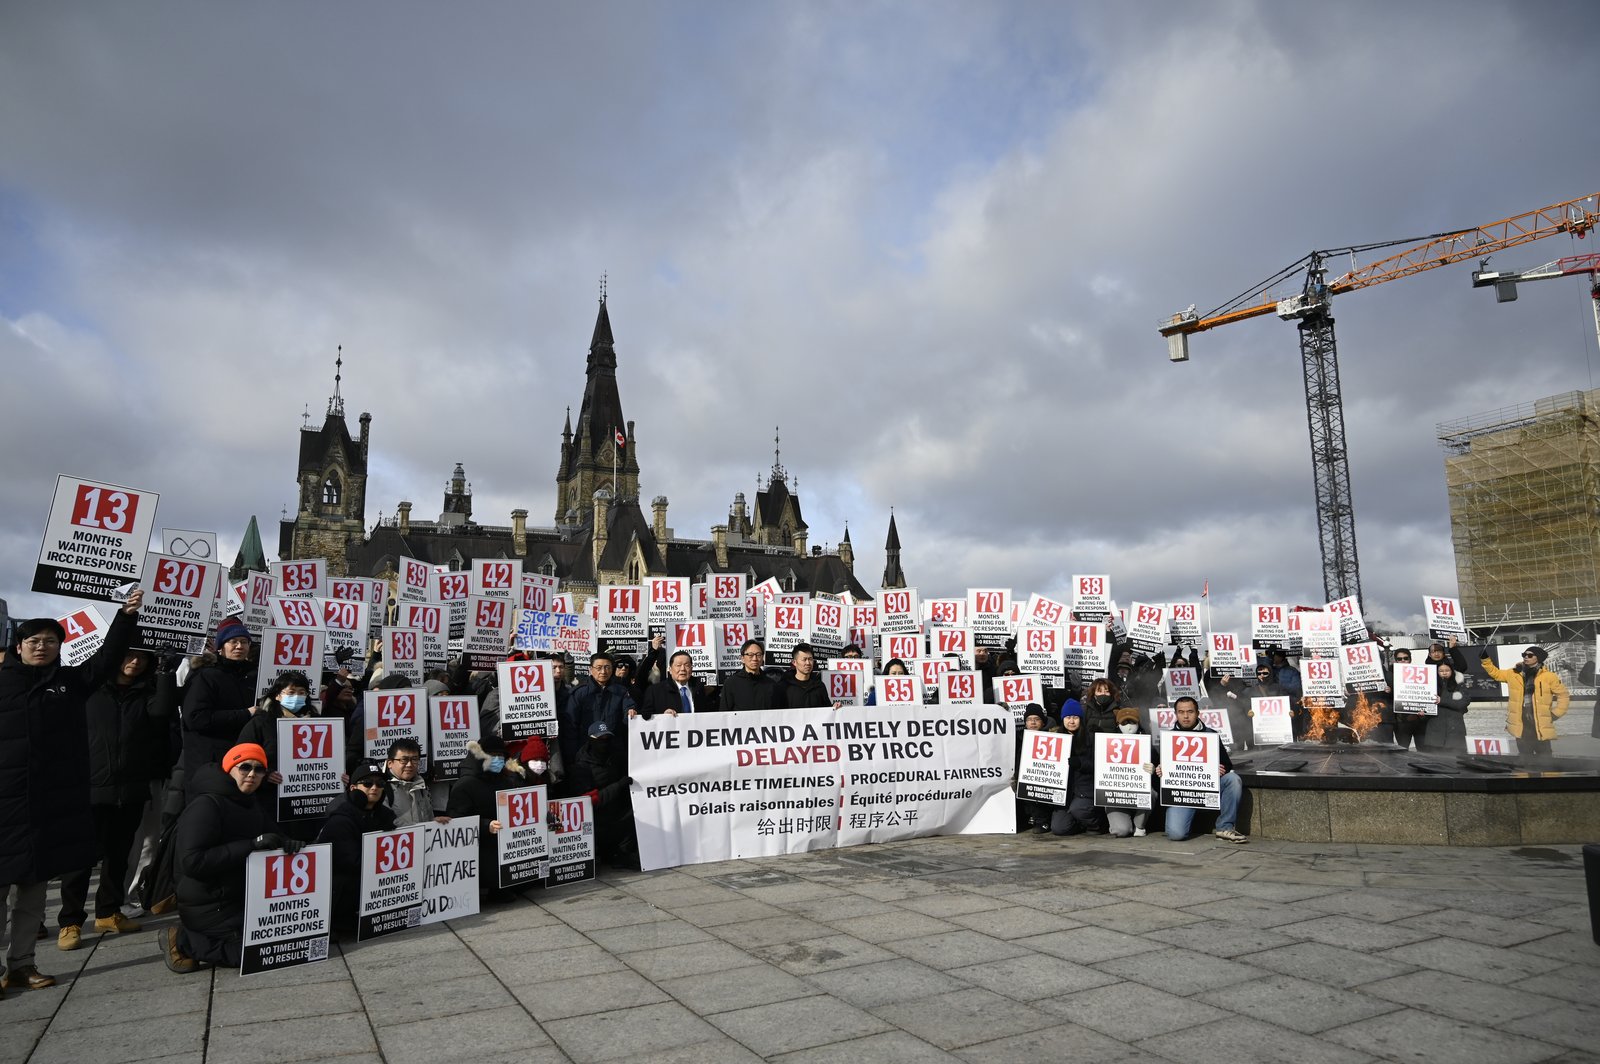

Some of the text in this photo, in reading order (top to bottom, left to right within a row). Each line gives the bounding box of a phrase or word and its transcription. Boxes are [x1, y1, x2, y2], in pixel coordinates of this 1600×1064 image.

[79, 488, 130, 531] 13
[73, 531, 122, 547] MONTHS
[58, 540, 132, 562] WAITING FOR
[47, 551, 137, 574] IRCC RESPONSE
[55, 571, 122, 586] NO TIMELINES
[159, 561, 200, 596] 30
[286, 564, 314, 590] 35
[408, 564, 425, 588] 39
[486, 564, 510, 588] 42
[1082, 578, 1102, 594] 38
[58, 582, 114, 596] NO RESULTS
[254, 578, 270, 606] 20
[442, 576, 466, 600] 32
[526, 586, 545, 610] 40
[656, 581, 678, 602] 15
[718, 578, 736, 598] 53
[155, 597, 193, 608] MONTHS
[613, 590, 636, 612] 11
[888, 592, 908, 612] 90
[979, 592, 1000, 612] 70
[1036, 600, 1060, 622] 35
[1434, 600, 1452, 616] 37
[138, 615, 204, 630] RCC RESPONSE
[144, 606, 200, 620] WAITING FOR
[284, 600, 314, 626] 36
[327, 602, 354, 629] 20
[412, 607, 437, 632] 40
[479, 601, 501, 628] 54
[523, 610, 578, 626] STOP THE
[778, 607, 800, 629] 34
[819, 606, 838, 626] 68
[856, 608, 874, 626] 55
[935, 603, 954, 622] 33
[1140, 606, 1159, 625] 32
[1175, 605, 1193, 620] 28
[1261, 608, 1279, 622] 31
[67, 616, 84, 635] 4
[680, 624, 702, 646] 71
[727, 624, 746, 646] 53
[70, 634, 100, 649] MONTHS
[154, 631, 192, 642] TIMELINES
[394, 633, 415, 659] 38
[552, 638, 590, 652] TOGETHER
[941, 631, 962, 651] 72
[1030, 630, 1052, 651] 65
[1073, 626, 1093, 646] 11
[1216, 634, 1231, 650] 37
[68, 642, 96, 658] WAITING
[278, 634, 309, 665] 34
[892, 638, 915, 658] 40
[1349, 647, 1370, 665] 39
[514, 665, 540, 692] 62
[1173, 671, 1189, 686] 37
[1311, 662, 1330, 679] 39
[834, 674, 853, 697] 81
[888, 679, 909, 701] 35
[951, 675, 972, 698] 43
[1006, 678, 1030, 702] 34
[508, 704, 535, 712] WAITING
[514, 694, 542, 702] MONTHS
[382, 696, 412, 726] 42
[444, 702, 466, 730] 41
[520, 710, 552, 718] RESPONSE
[298, 725, 328, 758] 37
[640, 718, 1006, 750] WE DEMAND A TIMELY DECISION
[736, 742, 934, 767] DELAYED BY IRCC
[1035, 736, 1058, 762] 51
[1109, 738, 1136, 764] 37
[1175, 736, 1204, 762] 22
[288, 772, 336, 782] WAITING FOR
[297, 763, 328, 772] MONTHS
[1168, 772, 1196, 780] WAITING
[284, 782, 340, 793] IRCC RESPONSE
[646, 766, 1002, 798] REASONABLE TIMELINES PROCEDURAL FAIRNESS
[1180, 780, 1216, 788] RESPONSE
[512, 792, 536, 826] 31
[689, 788, 972, 816] Délais raisonnables Équité procédurale
[562, 802, 582, 832] 40
[758, 810, 918, 836] 给出时限 程序公平
[512, 828, 536, 840] MONTHS
[380, 834, 410, 872] 36
[503, 844, 546, 861] IRCC RESPONSE
[506, 839, 530, 850] WAITING
[271, 854, 310, 897] 18
[378, 874, 409, 888] MONTHS
[424, 860, 476, 889] HAT ARE
[370, 882, 416, 900] WAITING FOR
[269, 898, 310, 913] MONTHS
[365, 892, 420, 912] IRCC RESPONSE
[422, 898, 436, 918] OU
[258, 908, 319, 926] WAITING FOR
[250, 920, 324, 940] IRCC RESPONSE
[260, 947, 271, 956] NO
[262, 950, 309, 966] NO RESULTS
